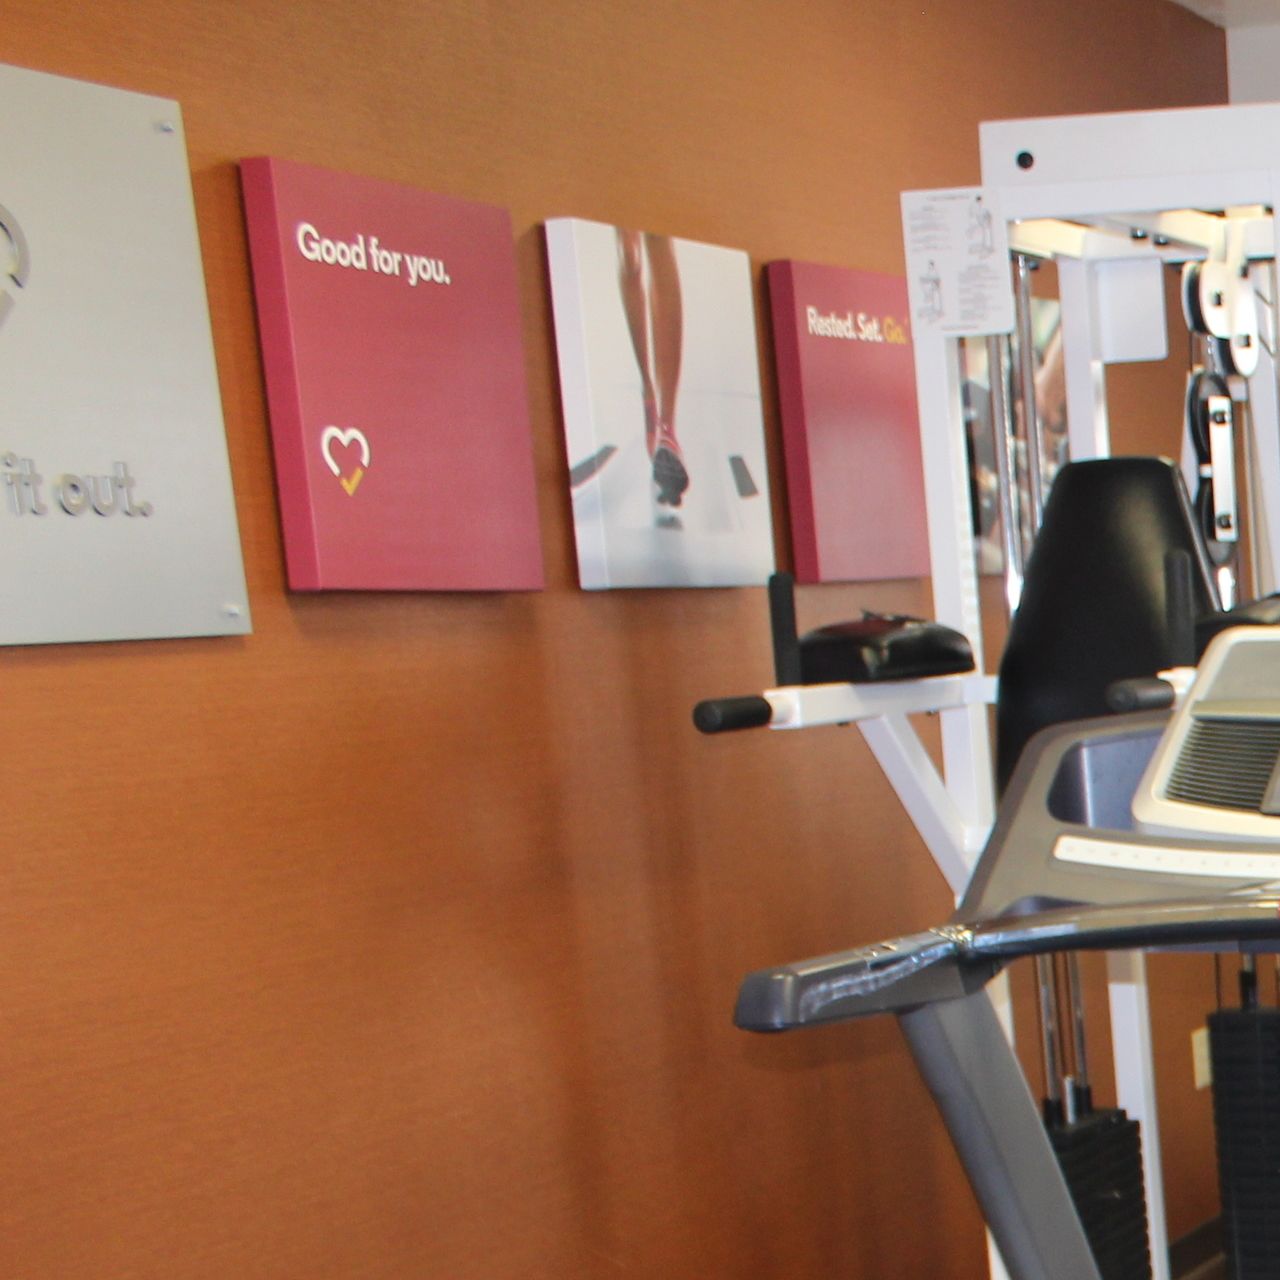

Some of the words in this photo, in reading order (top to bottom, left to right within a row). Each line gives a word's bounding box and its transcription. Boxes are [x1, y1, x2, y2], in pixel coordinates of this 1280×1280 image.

[296, 222, 368, 270] Good
[369, 236, 403, 276] for
[404, 254, 451, 286] you.
[806, 305, 857, 339] Rested.
[857, 312, 884, 342] Set.
[53, 461, 155, 517] out.
